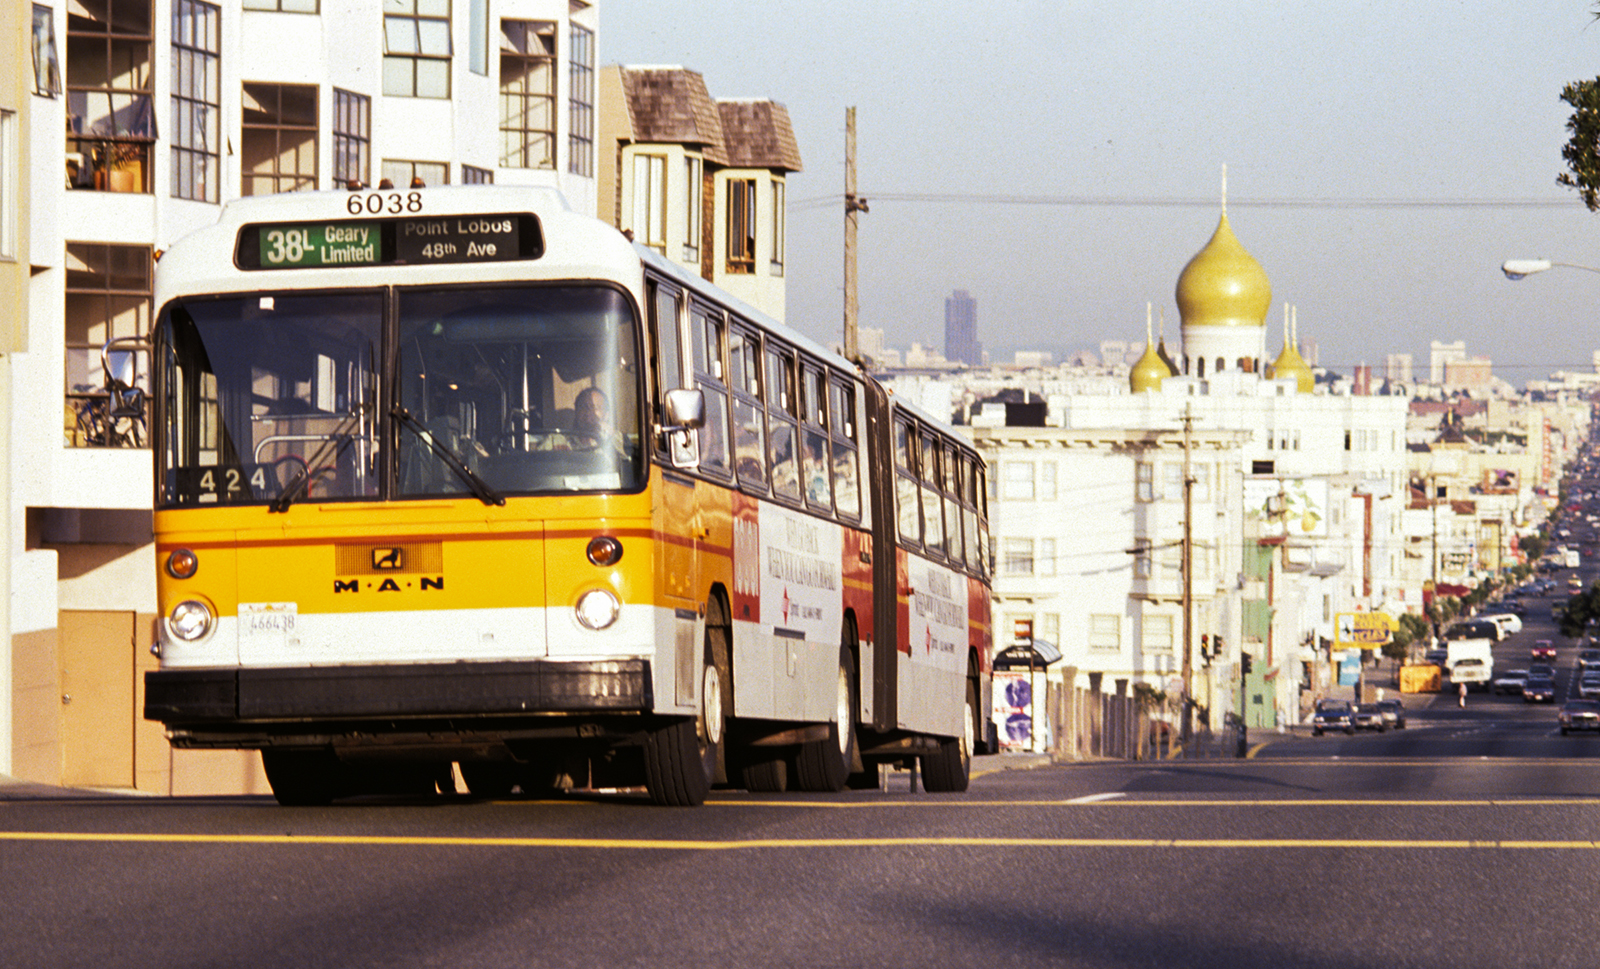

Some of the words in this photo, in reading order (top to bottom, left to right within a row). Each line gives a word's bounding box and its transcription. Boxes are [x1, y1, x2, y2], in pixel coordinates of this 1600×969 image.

[347, 192, 423, 215] 6038
[325, 225, 369, 246] Geary
[405, 220, 449, 237] Point
[457, 219, 513, 234] Lobos
[321, 243, 375, 264] Limited
[422, 242, 457, 259] 48th
[466, 240, 497, 257] Ave
[250, 614, 295, 630] 466438
